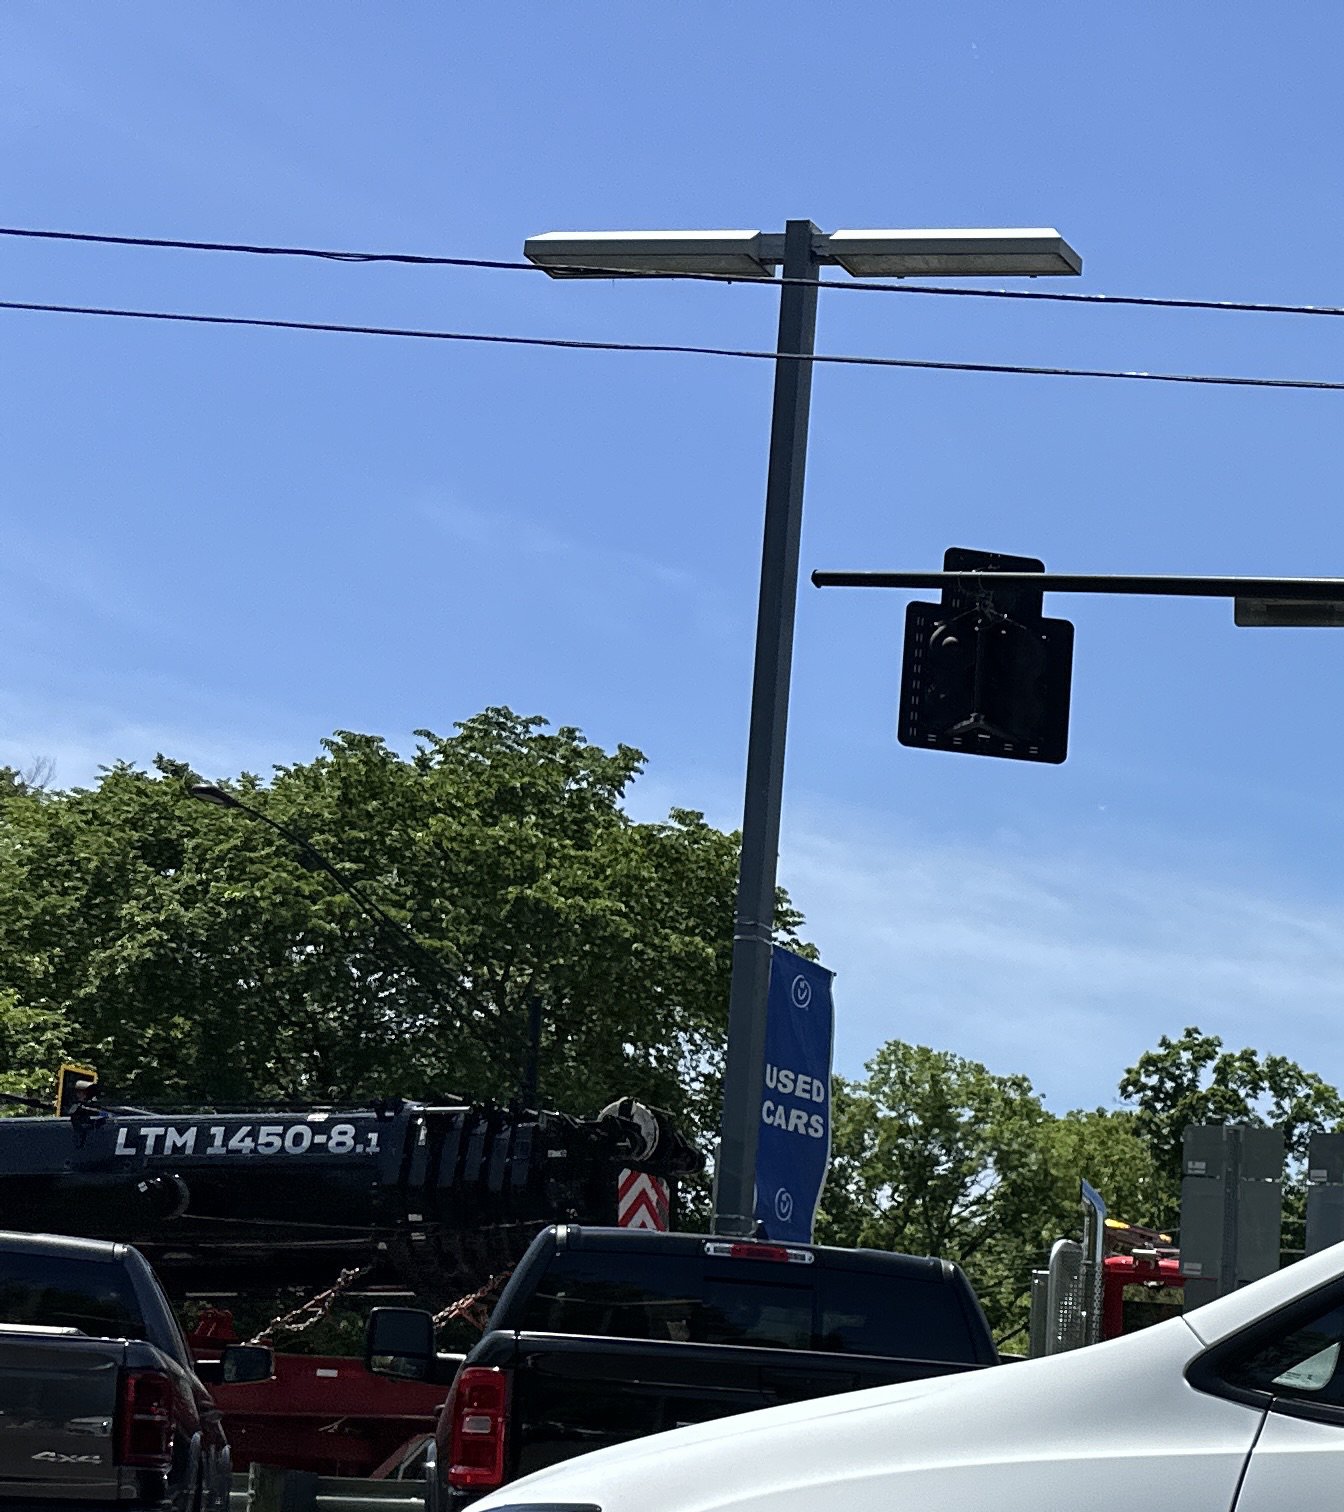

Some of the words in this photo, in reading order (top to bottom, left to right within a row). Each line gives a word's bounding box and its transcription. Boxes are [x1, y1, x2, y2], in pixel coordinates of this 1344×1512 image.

[766, 1064, 825, 1102] USED
[762, 1100, 824, 1138] CARS
[114, 1127, 198, 1155] LTM
[206, 1124, 380, 1155] 1450-8.1
